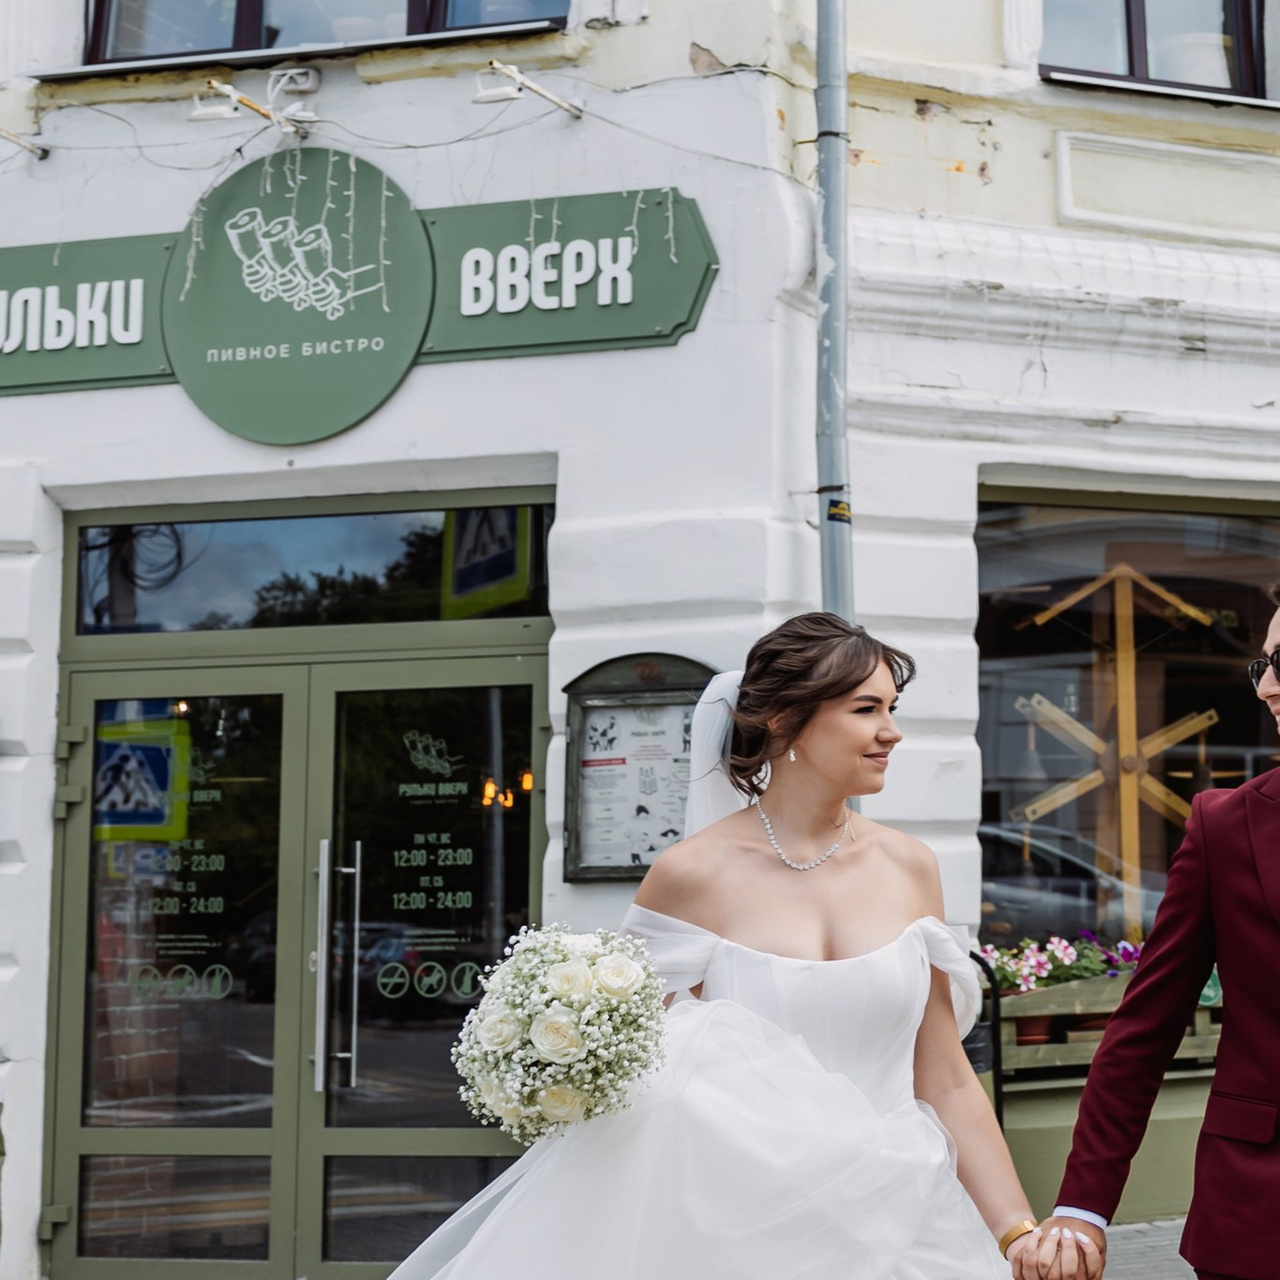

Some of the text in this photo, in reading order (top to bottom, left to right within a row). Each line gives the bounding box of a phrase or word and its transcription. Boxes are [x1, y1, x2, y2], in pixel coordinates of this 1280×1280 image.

[0, 236, 633, 354] ЛЬКИ ВВЕРХ
[207, 337, 385, 362] ПИВНОЕ БИСТРО
[394, 850, 427, 867] 12:00
[437, 848, 473, 865] 23:00
[393, 893, 426, 909] 12:00
[437, 891, 472, 908] 24:00
